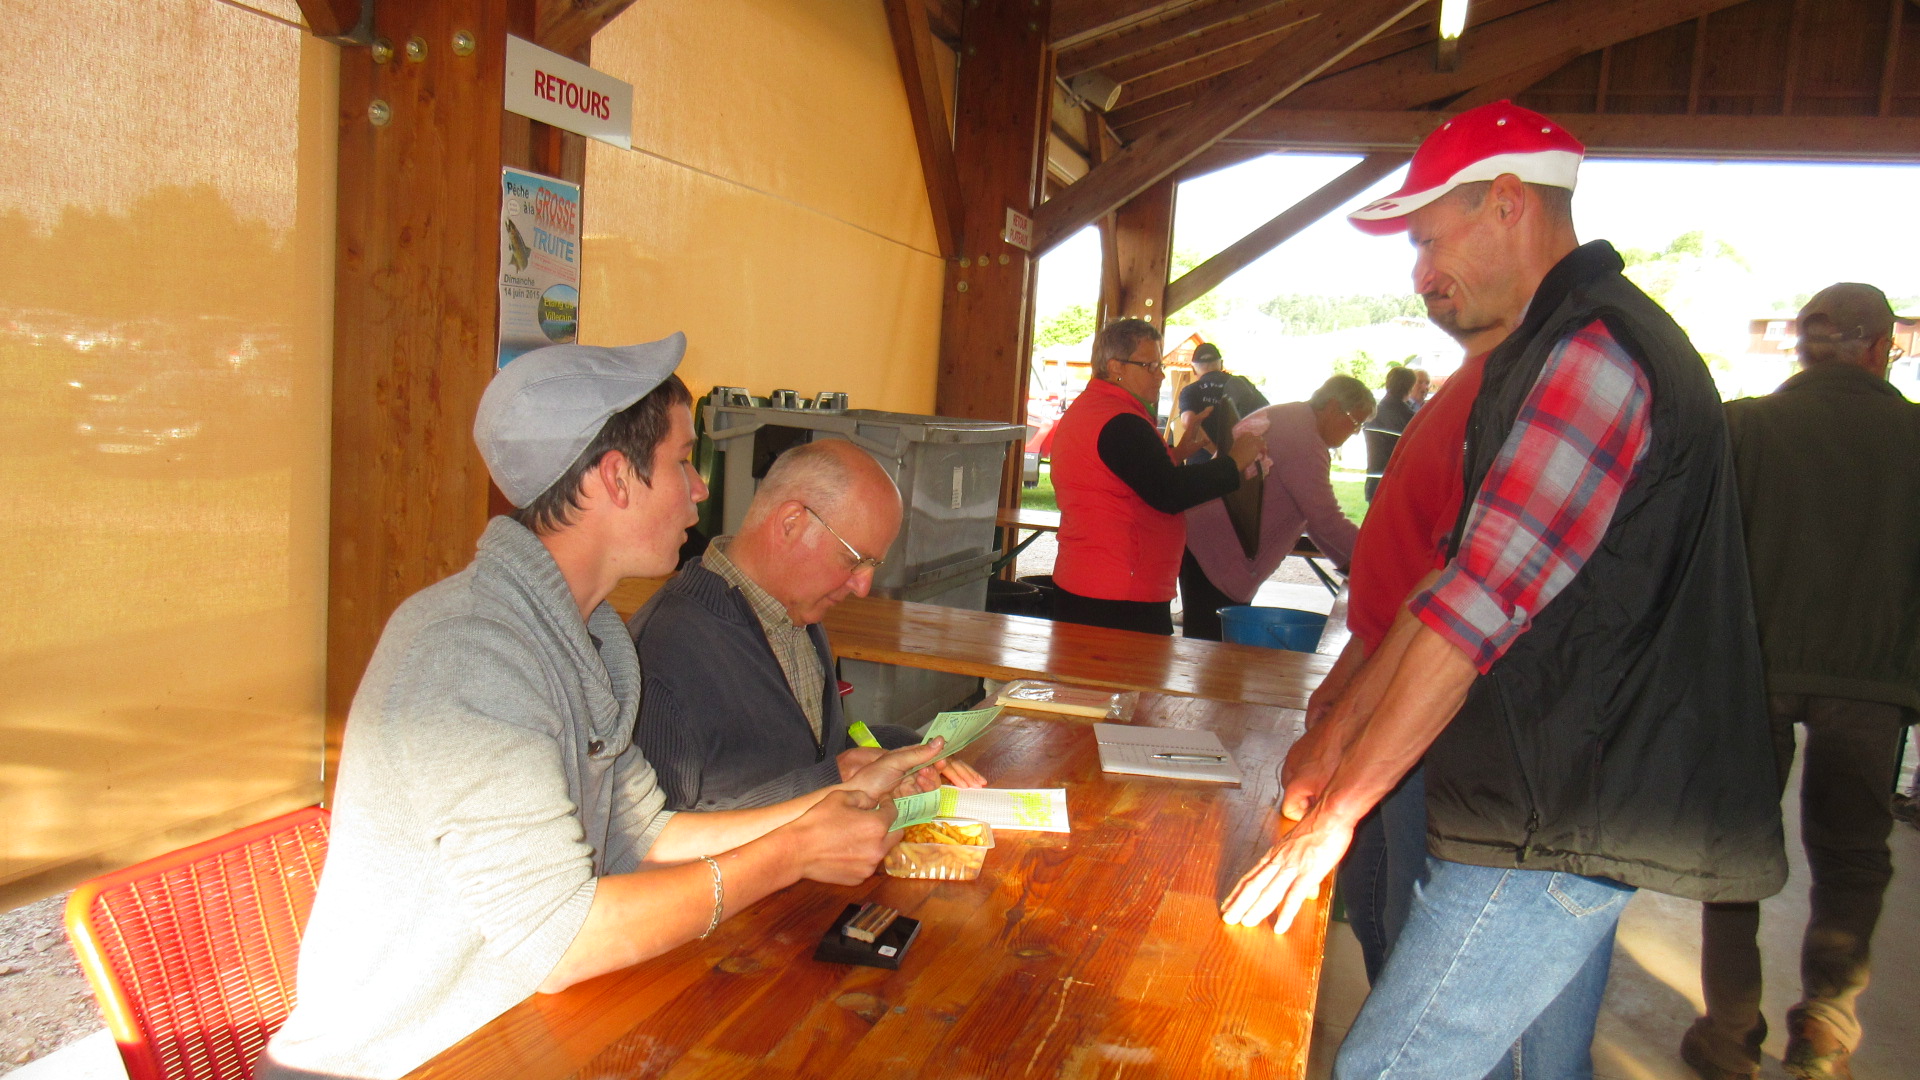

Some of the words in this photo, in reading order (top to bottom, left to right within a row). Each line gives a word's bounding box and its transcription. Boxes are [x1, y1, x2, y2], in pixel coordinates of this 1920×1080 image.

[534, 69, 610, 121] RETOURS
[506, 182, 530, 199] Pêche
[535, 186, 577, 228] GROSSE
[533, 226, 575, 263] TRUITE
[503, 273, 535, 287] Dimanche
[504, 287, 512, 297] 14
[512, 288, 525, 300] juin
[526, 289, 541, 300] 2015
